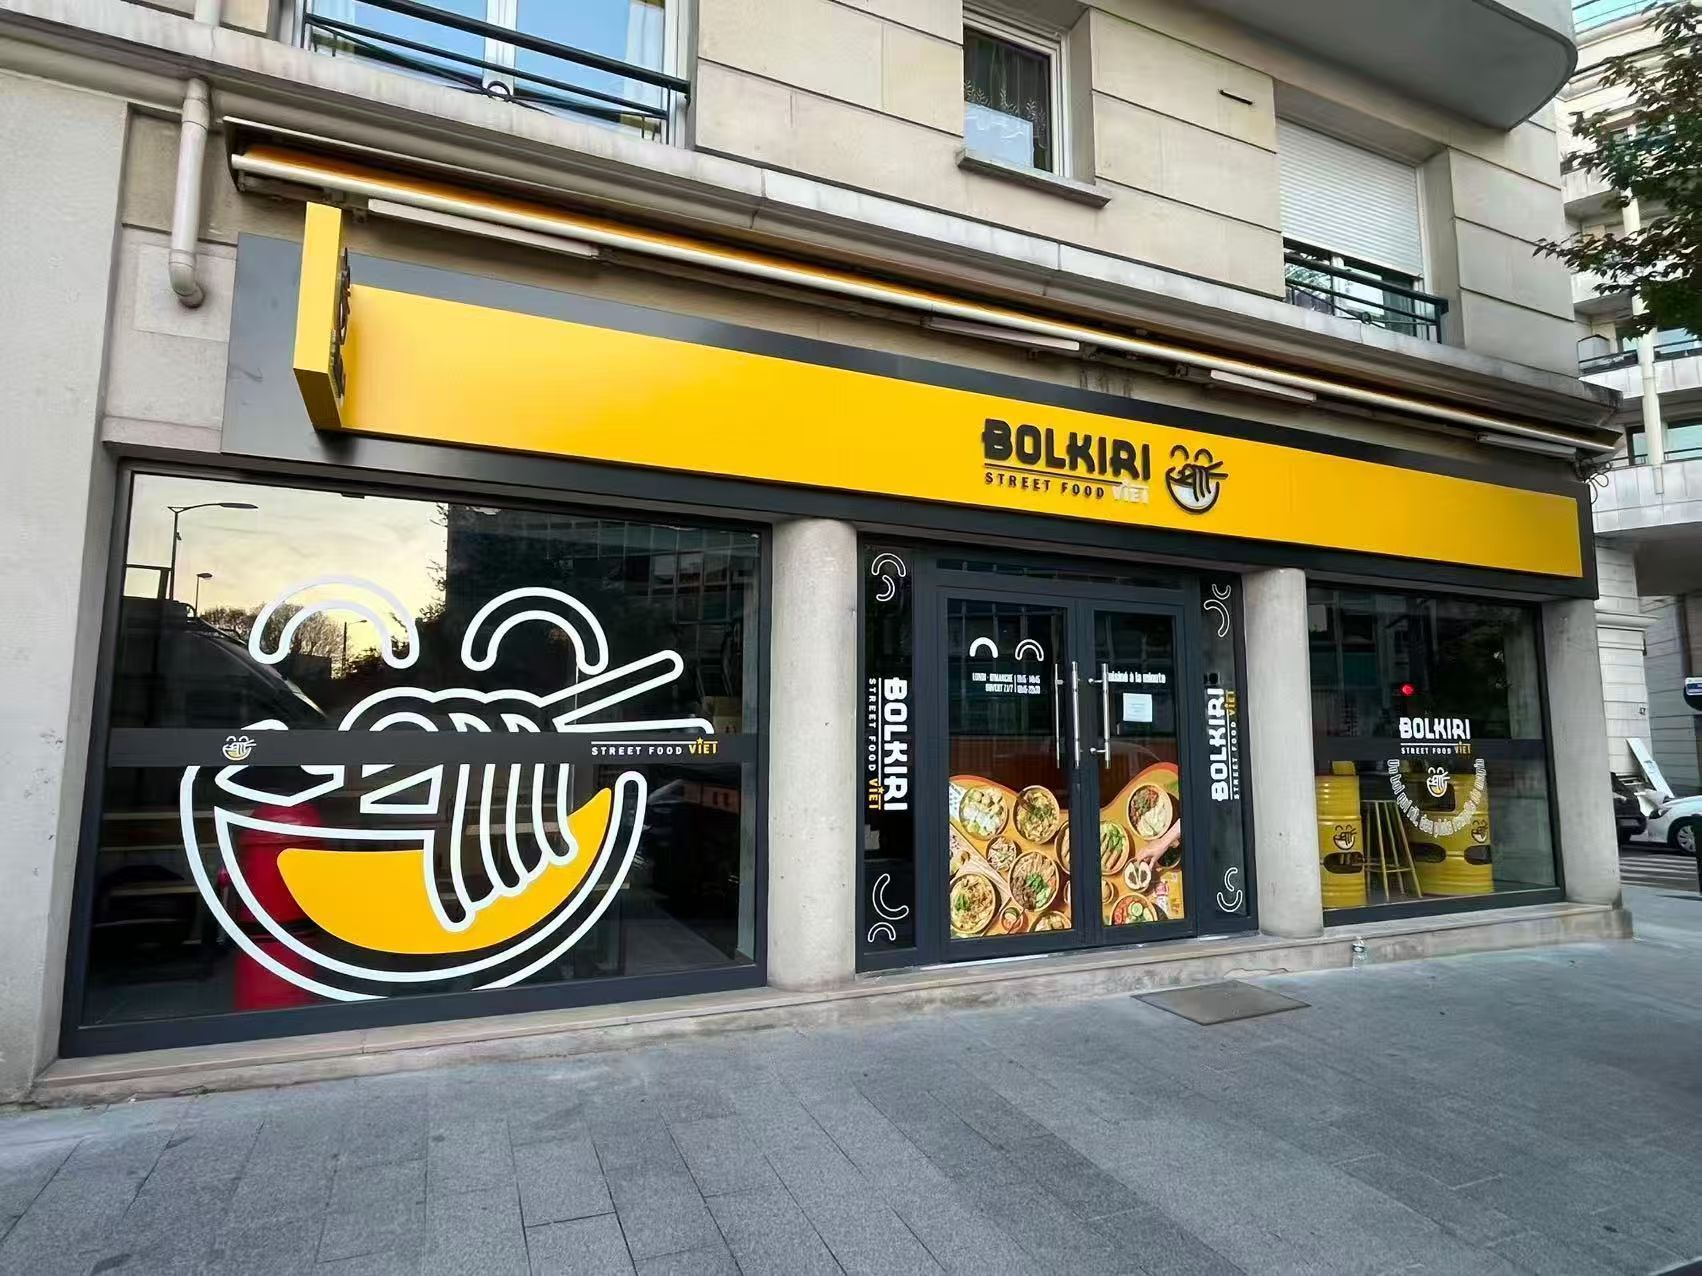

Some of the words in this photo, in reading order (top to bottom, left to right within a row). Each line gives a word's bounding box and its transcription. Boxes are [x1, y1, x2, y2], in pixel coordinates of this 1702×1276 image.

[981, 418, 1151, 481] BOLKIRI
[984, 471, 1051, 492] STREET
[1061, 482, 1105, 499] FOOD
[868, 678, 877, 728] STREET
[883, 677, 908, 810] BOLKIRI
[1207, 688, 1229, 801] BOLKIRI
[1230, 721, 1238, 751] FOOD
[1399, 717, 1471, 740] BOLKIRI
[591, 746, 642, 756] STREET
[648, 746, 683, 755] FOOD
[688, 742, 718, 755] VIET
[868, 735, 877, 771] FOOD
[1401, 747, 1429, 755] STREET
[1432, 747, 1452, 755] FOOD
[1454, 744, 1471, 754] VIET
[868, 778, 880, 810] VIET
[1231, 757, 1240, 800] STREET
